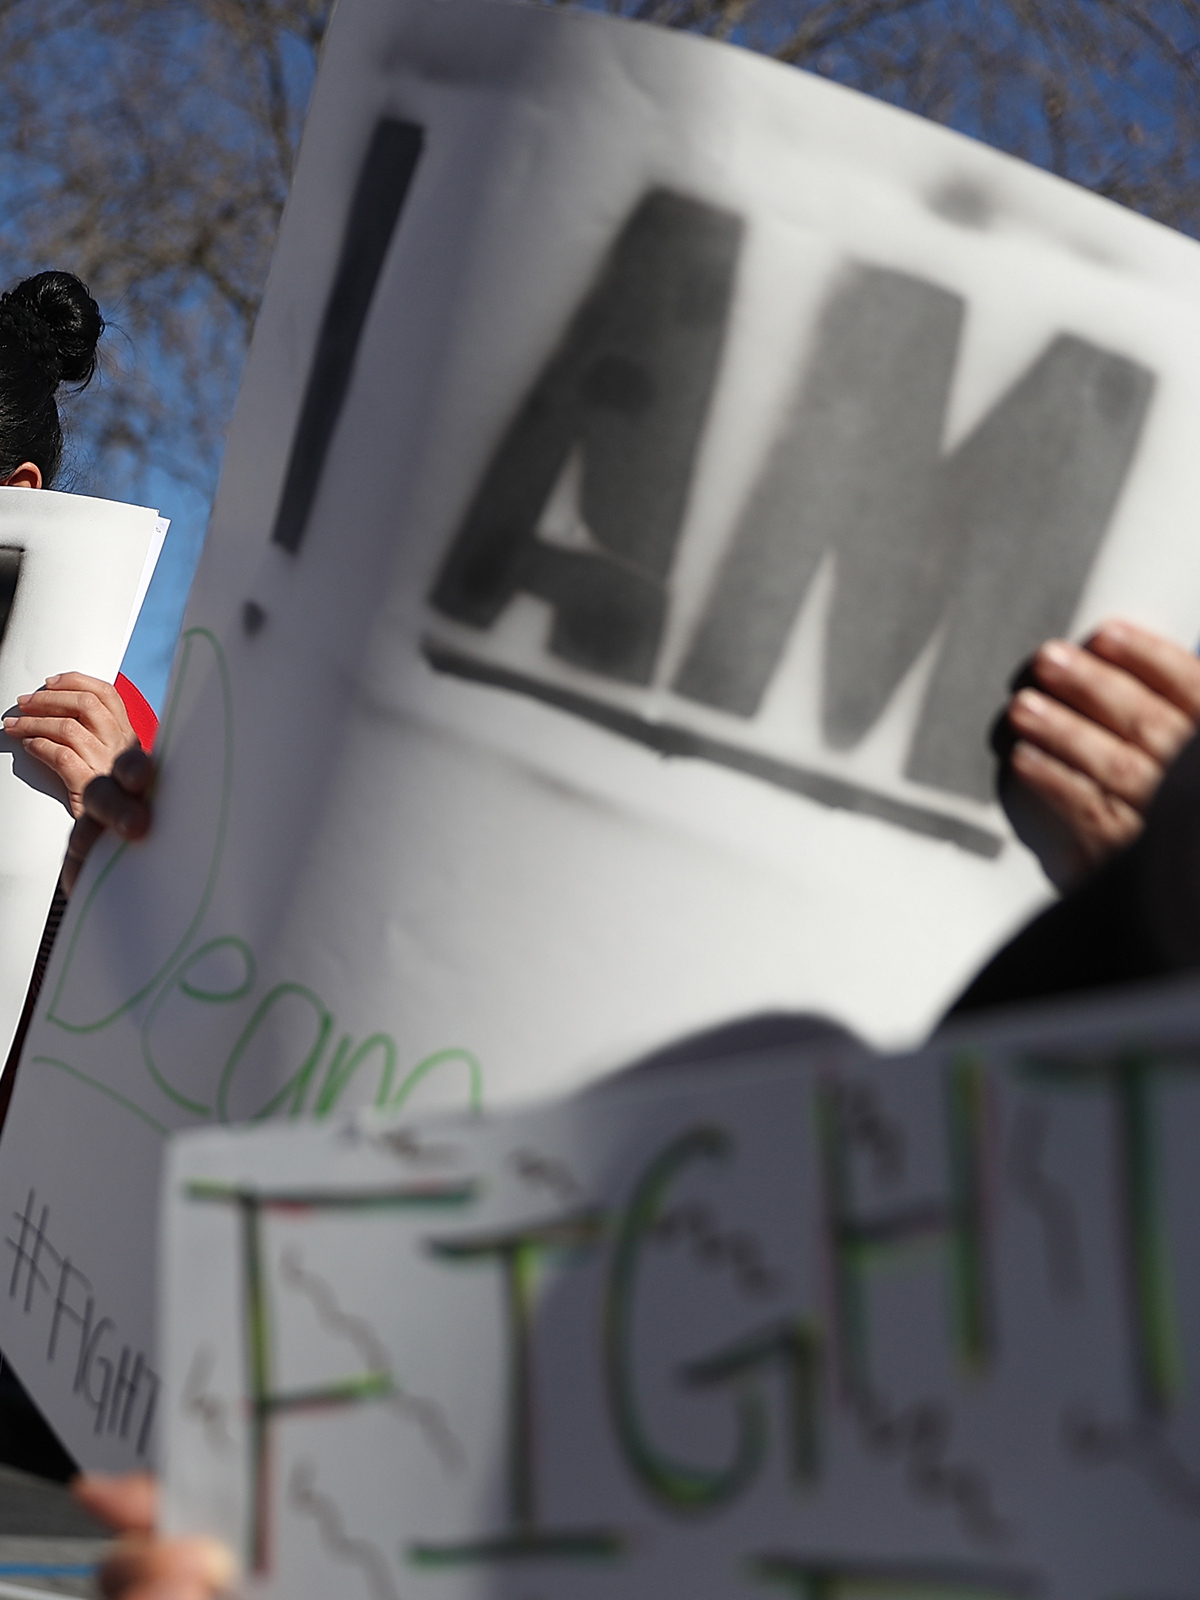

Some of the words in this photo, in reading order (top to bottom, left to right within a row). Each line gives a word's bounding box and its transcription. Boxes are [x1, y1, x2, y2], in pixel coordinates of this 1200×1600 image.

[272, 115, 426, 557] I
[424, 182, 1158, 808] AM
[182, 1038, 1200, 1578] FIGHT
